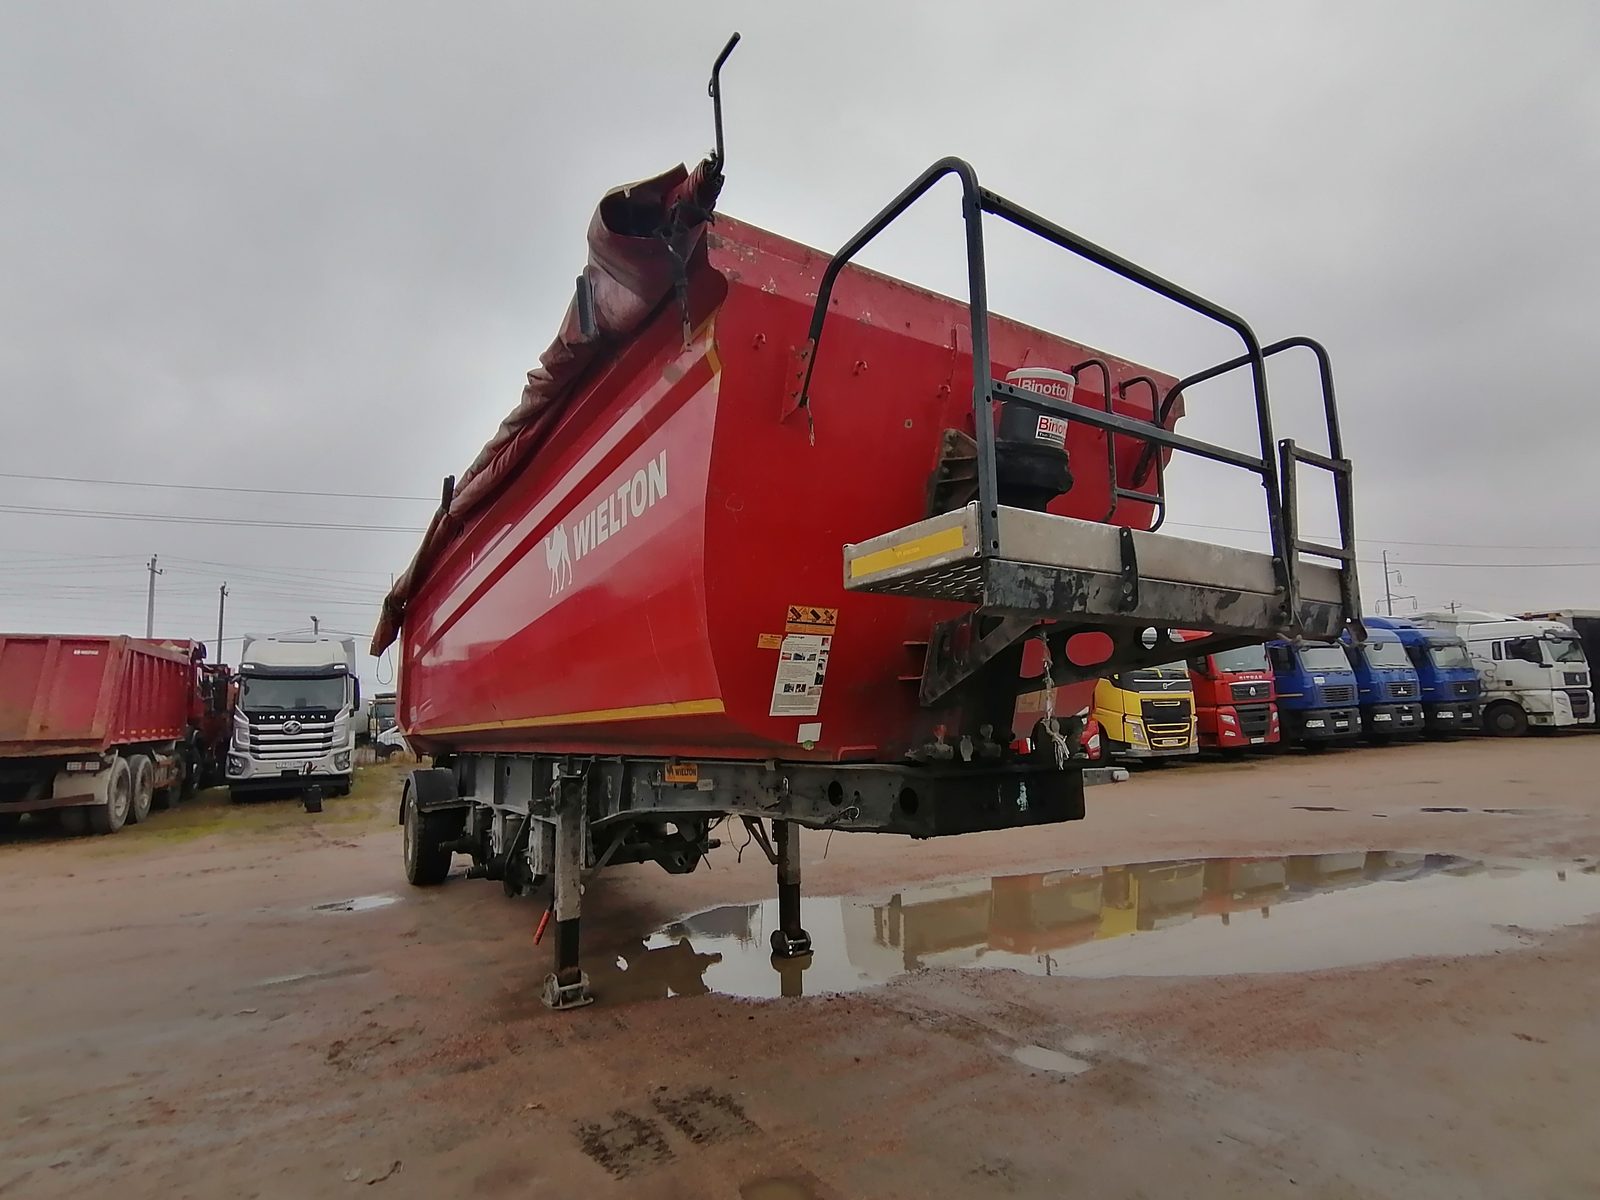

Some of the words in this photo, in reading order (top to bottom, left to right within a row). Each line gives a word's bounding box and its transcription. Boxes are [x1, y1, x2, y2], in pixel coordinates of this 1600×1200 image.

[1022, 379, 1067, 397] Binotto
[572, 449, 668, 561] WIELTON
[675, 767, 697, 776] WIELTON
